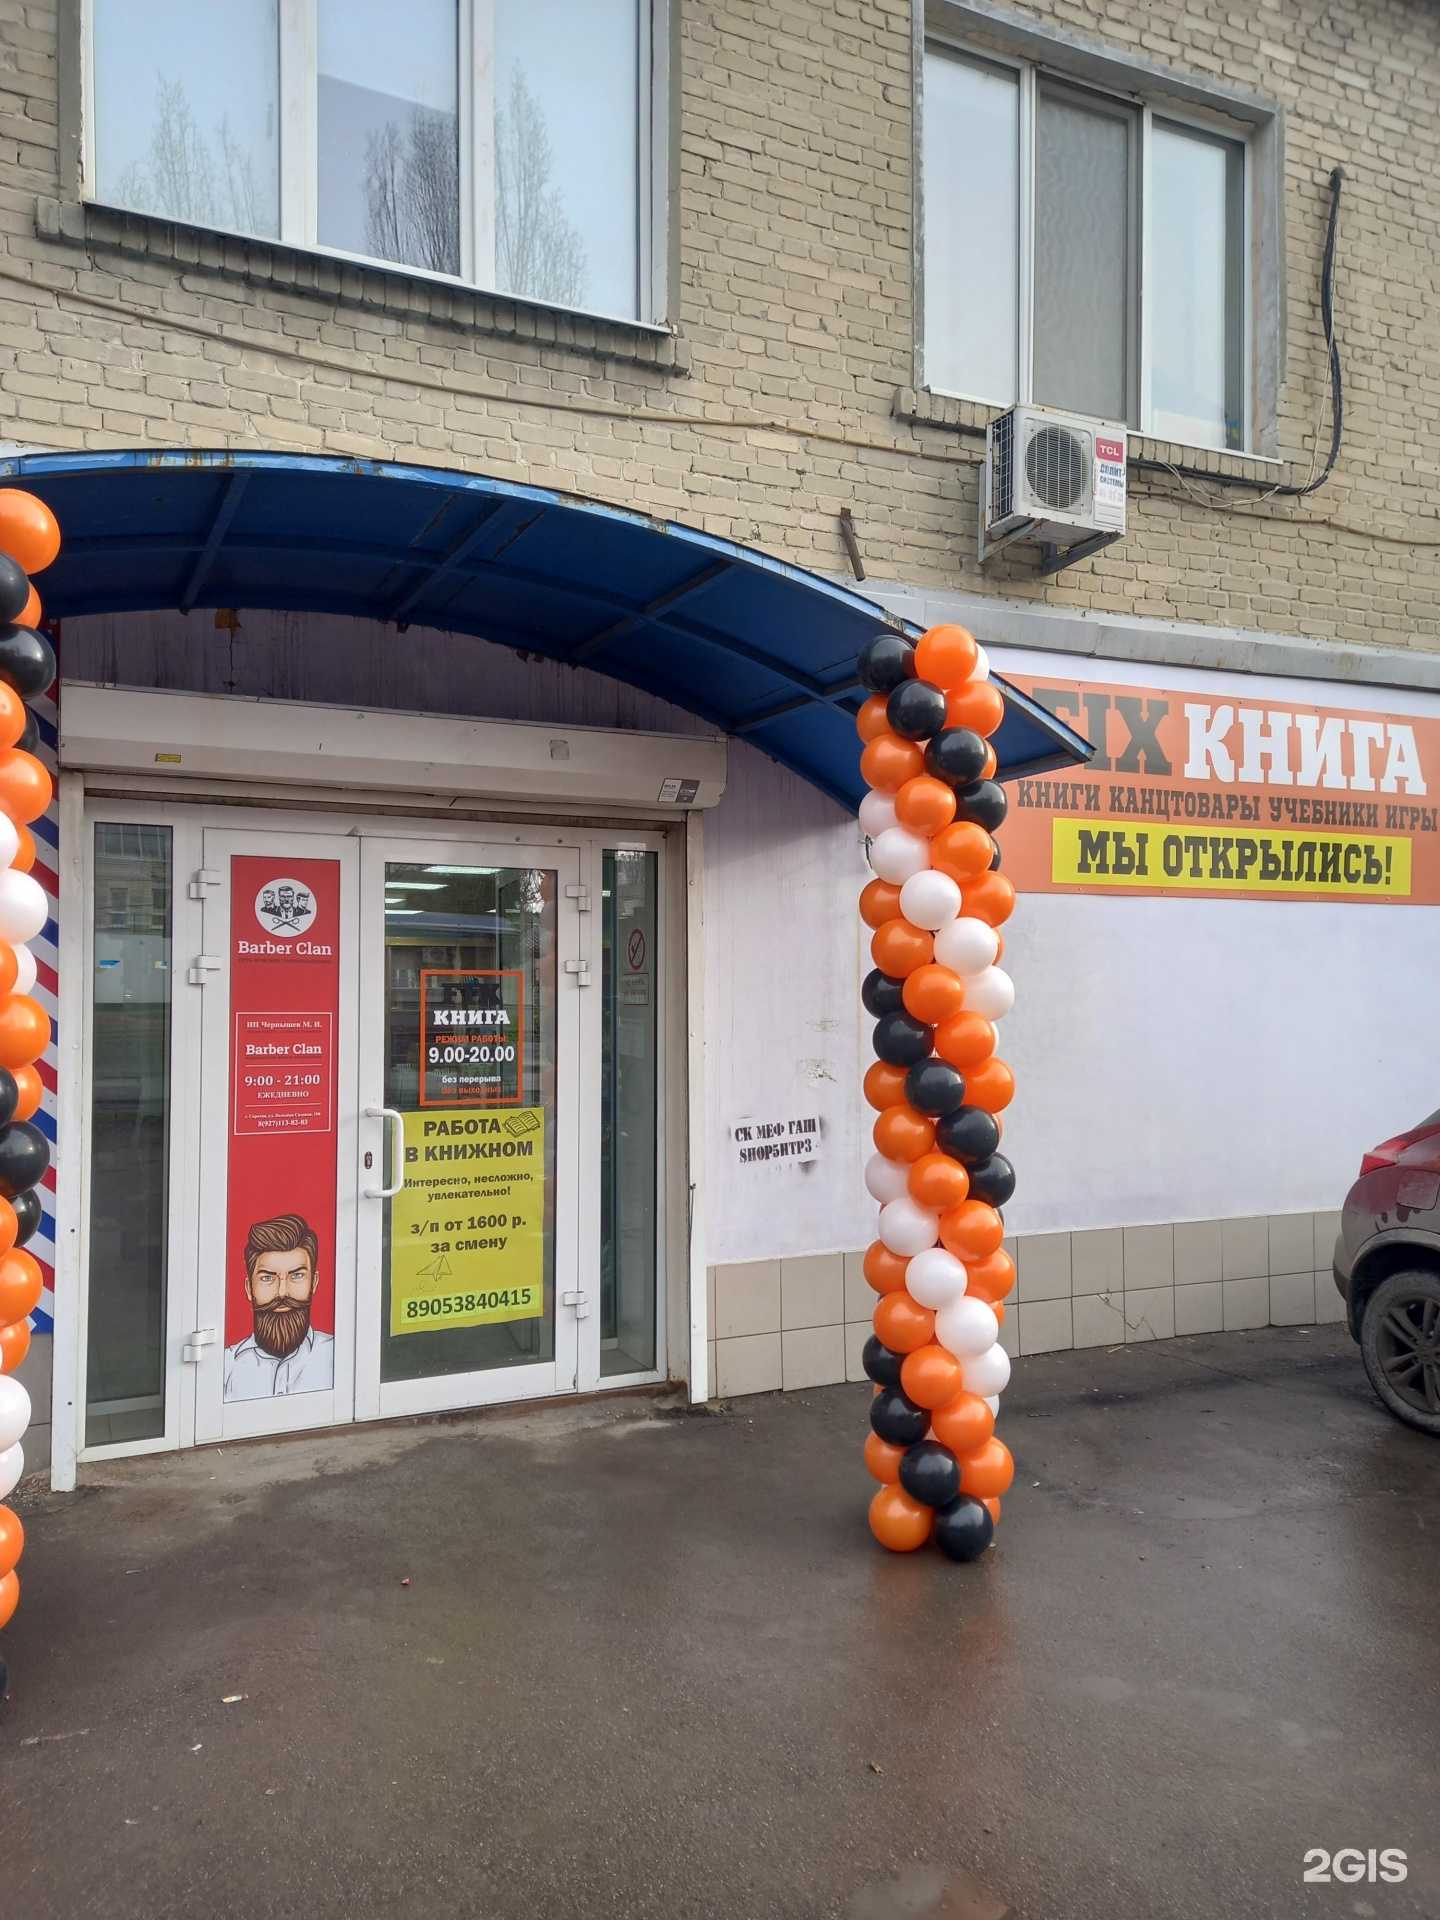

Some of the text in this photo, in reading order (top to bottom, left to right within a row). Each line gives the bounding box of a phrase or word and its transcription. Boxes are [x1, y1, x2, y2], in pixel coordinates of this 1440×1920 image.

[1100, 445, 1120, 456] TCL
[1184, 703, 1427, 795] КНИГА
[1018, 780, 1438, 832] КНИГИ КАНЦТОВАРЫ УЧЕБНИКИ ИГРЫ
[1077, 830, 1393, 885] МЫ ОТКРЫЛИСЬ!
[238, 940, 331, 955] Barber Clan
[433, 1010, 511, 1025] КНИГА
[435, 1034, 469, 1043] РЕЖИМ
[246, 1043, 321, 1055] Barber Clan
[429, 1046, 515, 1063] 9.00-20.00
[245, 1075, 273, 1086] 9:00
[284, 1074, 320, 1085] 21:00
[442, 1075, 501, 1084] без перерыва
[257, 1090, 309, 1099] ЕЖЕДНЕВНО
[423, 1118, 501, 1137] РАБОТА
[735, 1118, 816, 1142] СК МЕФ ГАШ
[405, 1141, 533, 1162] В КНИЖНОМ
[403, 1171, 534, 1188] Интересно, несложно,
[428, 1187, 511, 1202] увлекательно!
[410, 1214, 527, 1236] з/п от 1600 р.
[431, 1236, 507, 1253] за смену
[407, 1288, 531, 1318] 89053840415
